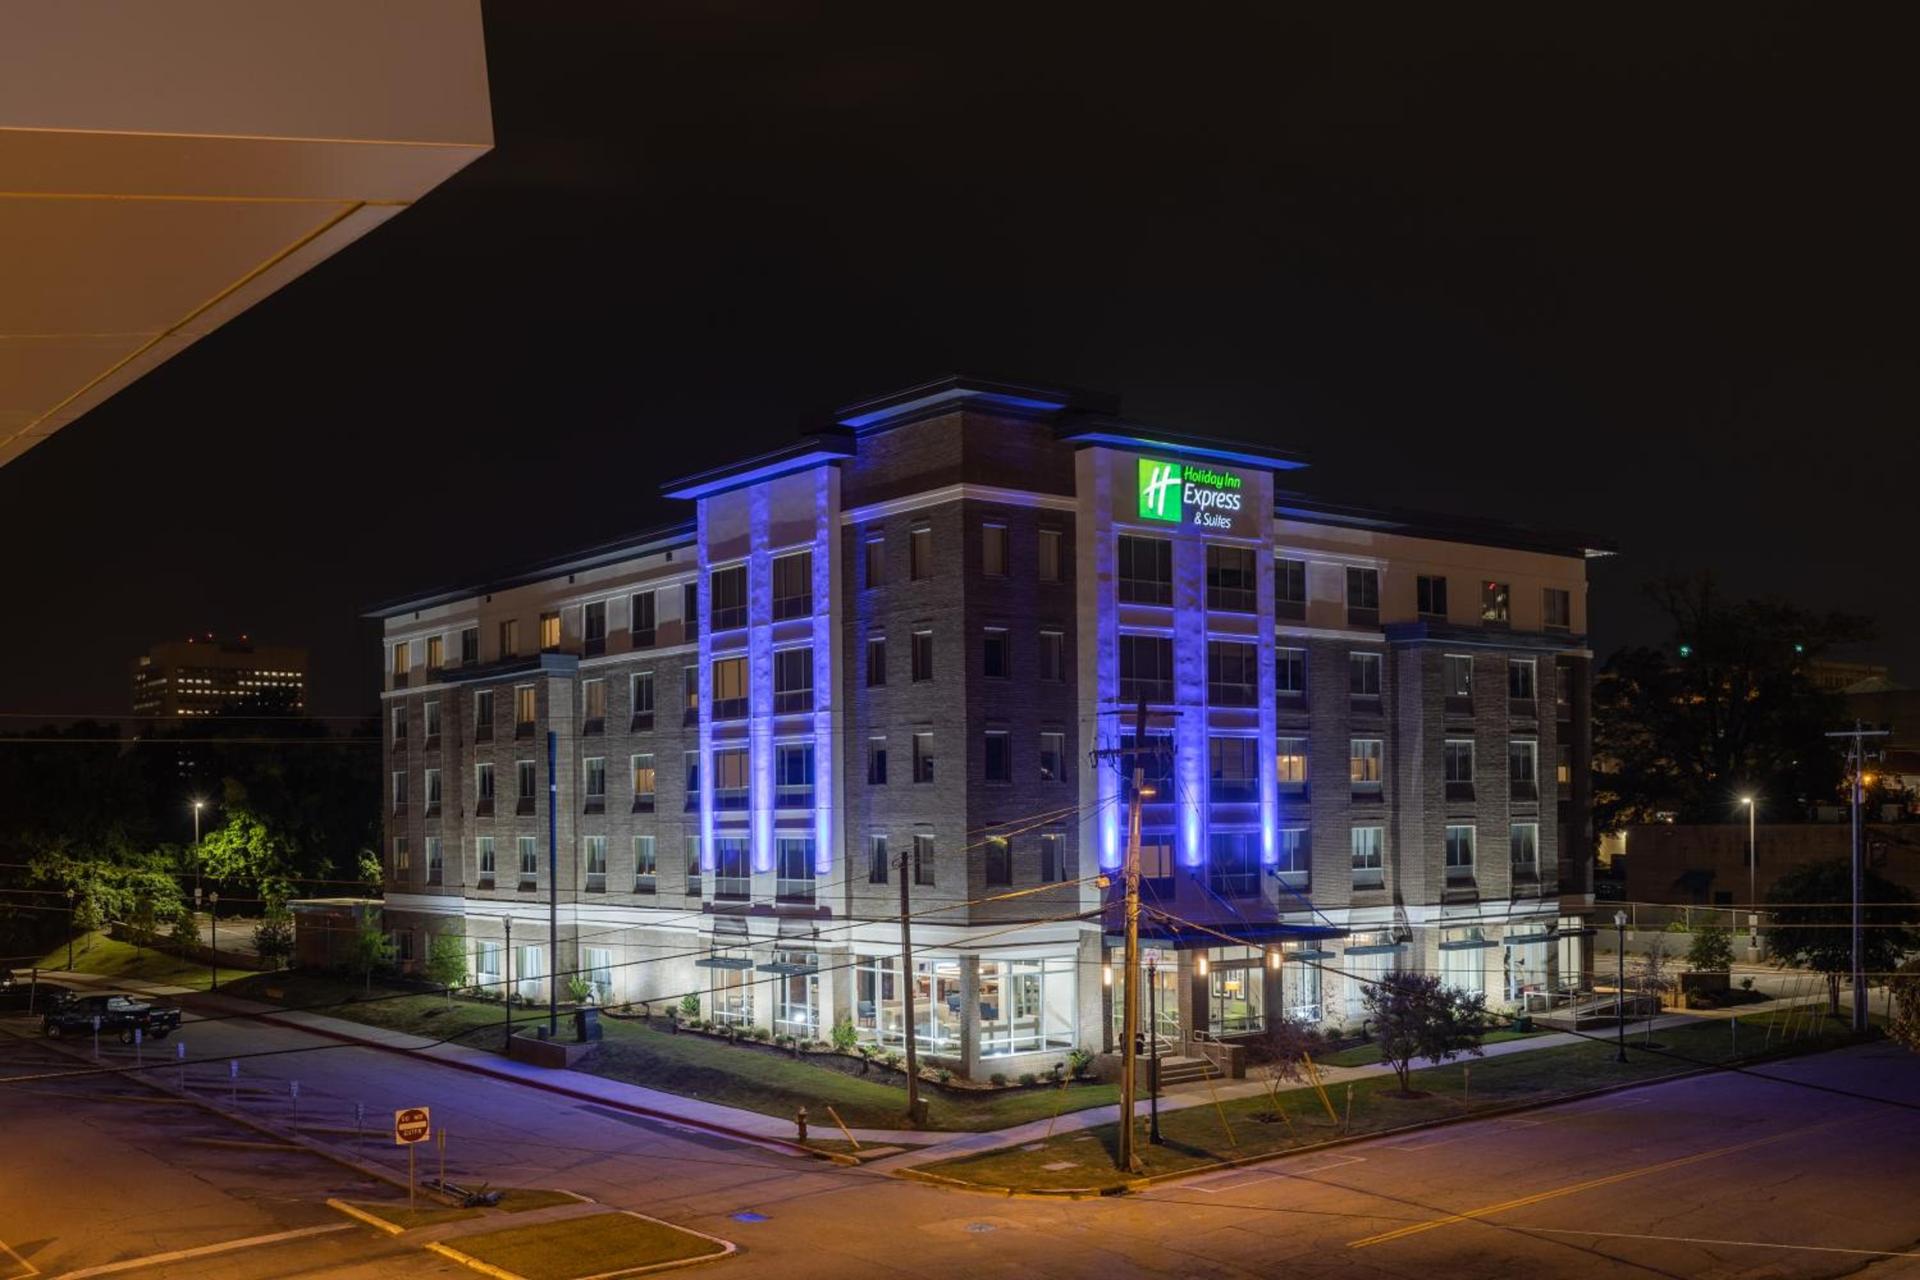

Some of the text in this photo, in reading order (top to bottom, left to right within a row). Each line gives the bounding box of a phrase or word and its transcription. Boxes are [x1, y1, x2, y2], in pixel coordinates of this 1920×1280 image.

[1184, 466, 1241, 489] Holiday Inn
[1183, 483, 1241, 511] Express
[1194, 512, 1232, 529] & Suites
